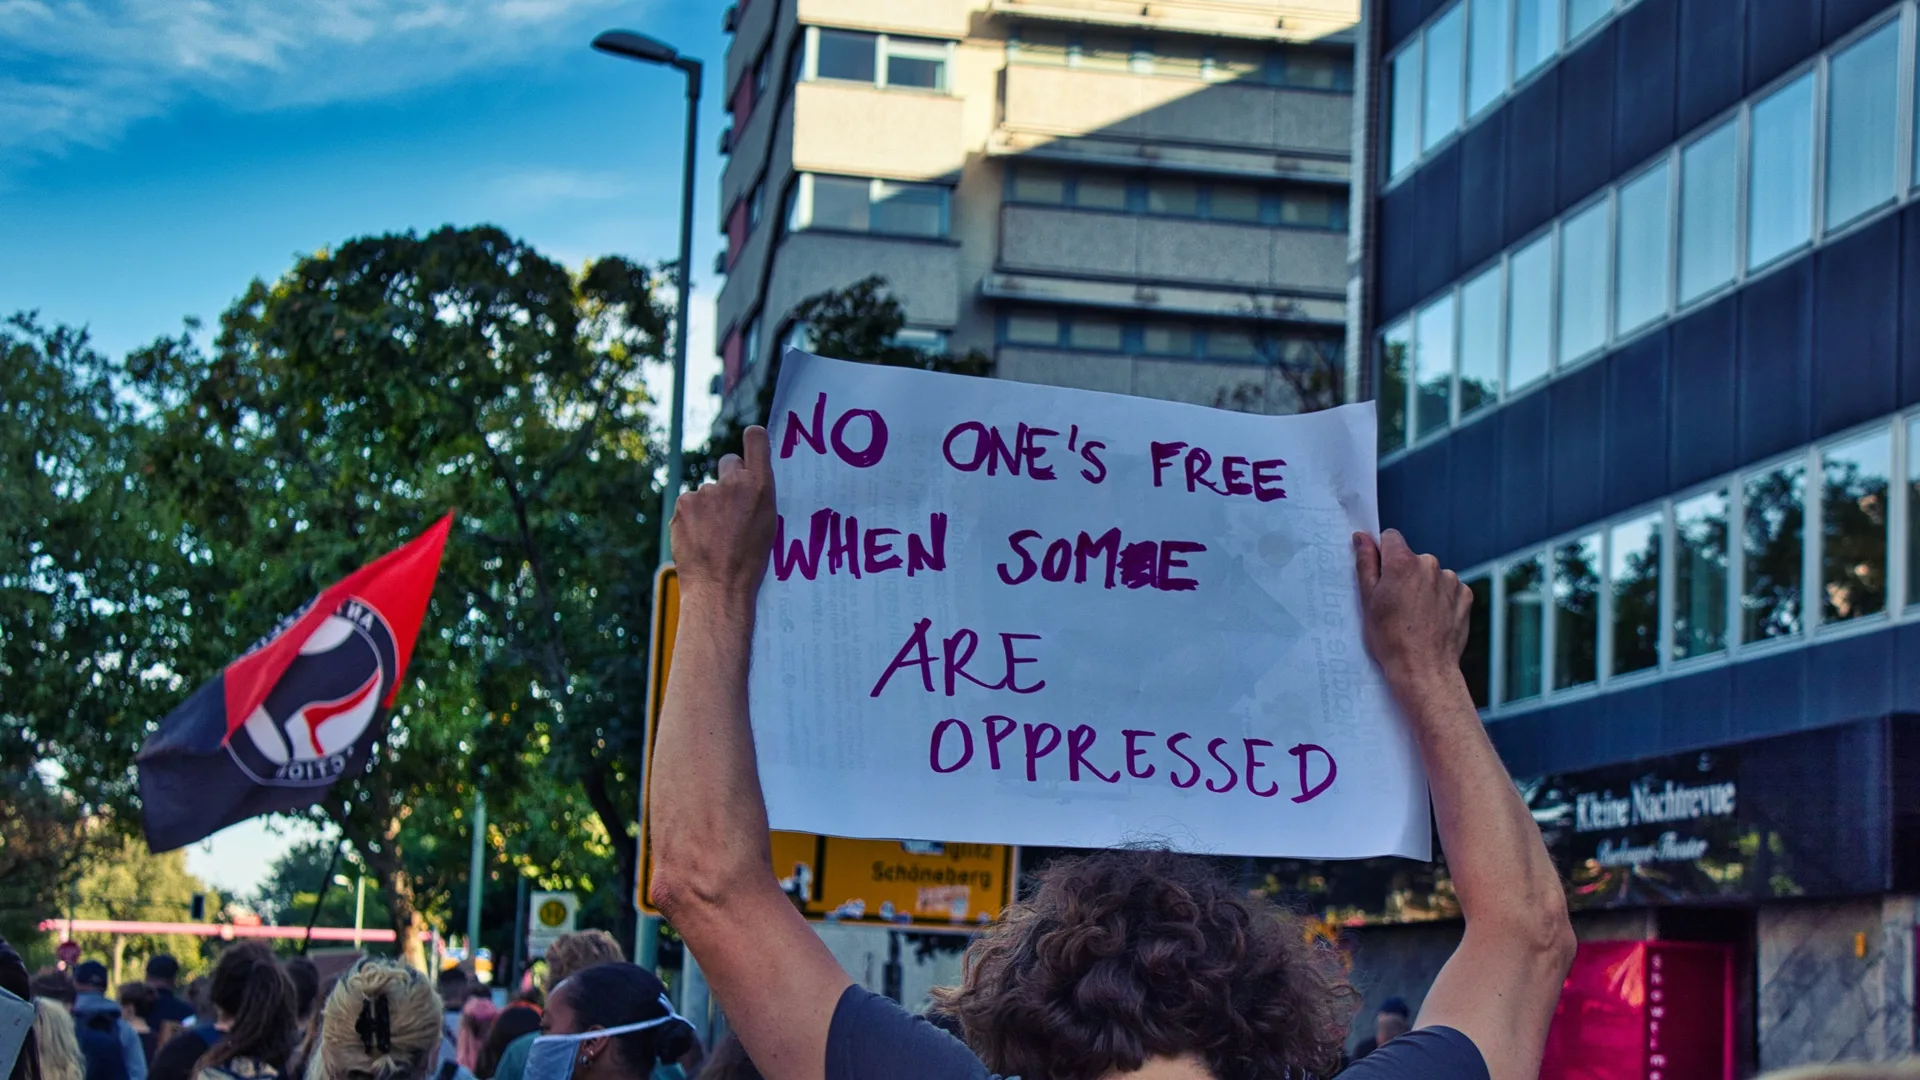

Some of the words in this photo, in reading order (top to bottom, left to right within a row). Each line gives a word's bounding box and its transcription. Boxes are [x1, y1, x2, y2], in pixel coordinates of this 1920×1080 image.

[780, 393, 888, 468] NO
[943, 422, 1107, 485] ONE'S
[1152, 442, 1286, 501] FREE
[773, 508, 947, 581] WHEN
[870, 618, 1045, 697] ARE
[930, 716, 1337, 804] OPPRESSED
[1575, 789, 1630, 833] Kleine
[1630, 779, 1737, 827] Nachtrevue
[872, 860, 993, 892] Schöneberg
